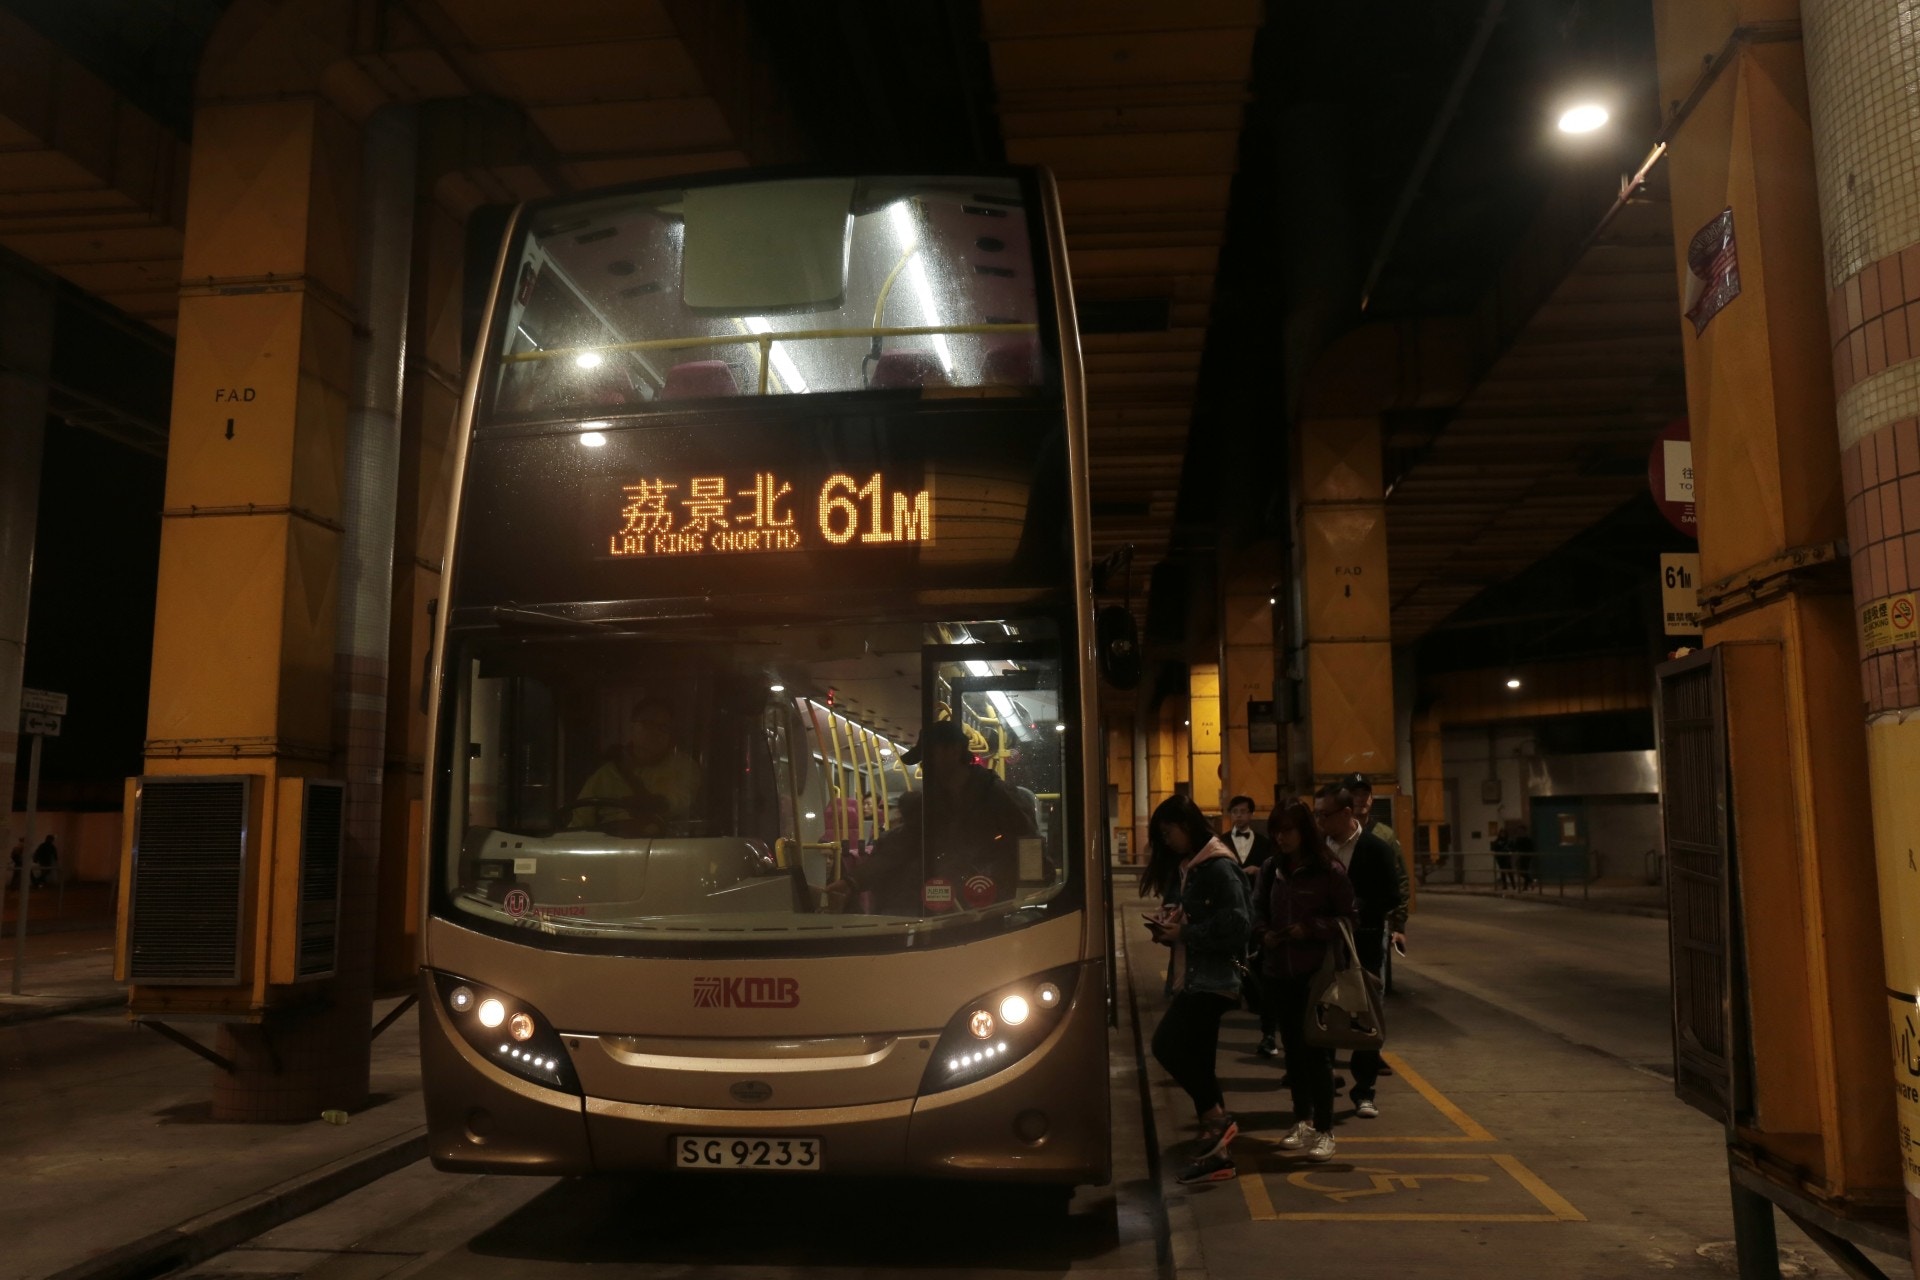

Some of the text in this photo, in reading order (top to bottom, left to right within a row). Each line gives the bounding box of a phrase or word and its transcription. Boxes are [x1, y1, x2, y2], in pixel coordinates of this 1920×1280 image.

[619, 473, 794, 534] 荔景北
[819, 473, 929, 543] 61M
[610, 535, 646, 555] LAI
[655, 533, 703, 552] KING
[1665, 566, 1692, 588] 61M
[532, 906, 585, 917] ATENU124
[723, 977, 801, 1008] KMB
[682, 1140, 815, 1166] SG 9233
